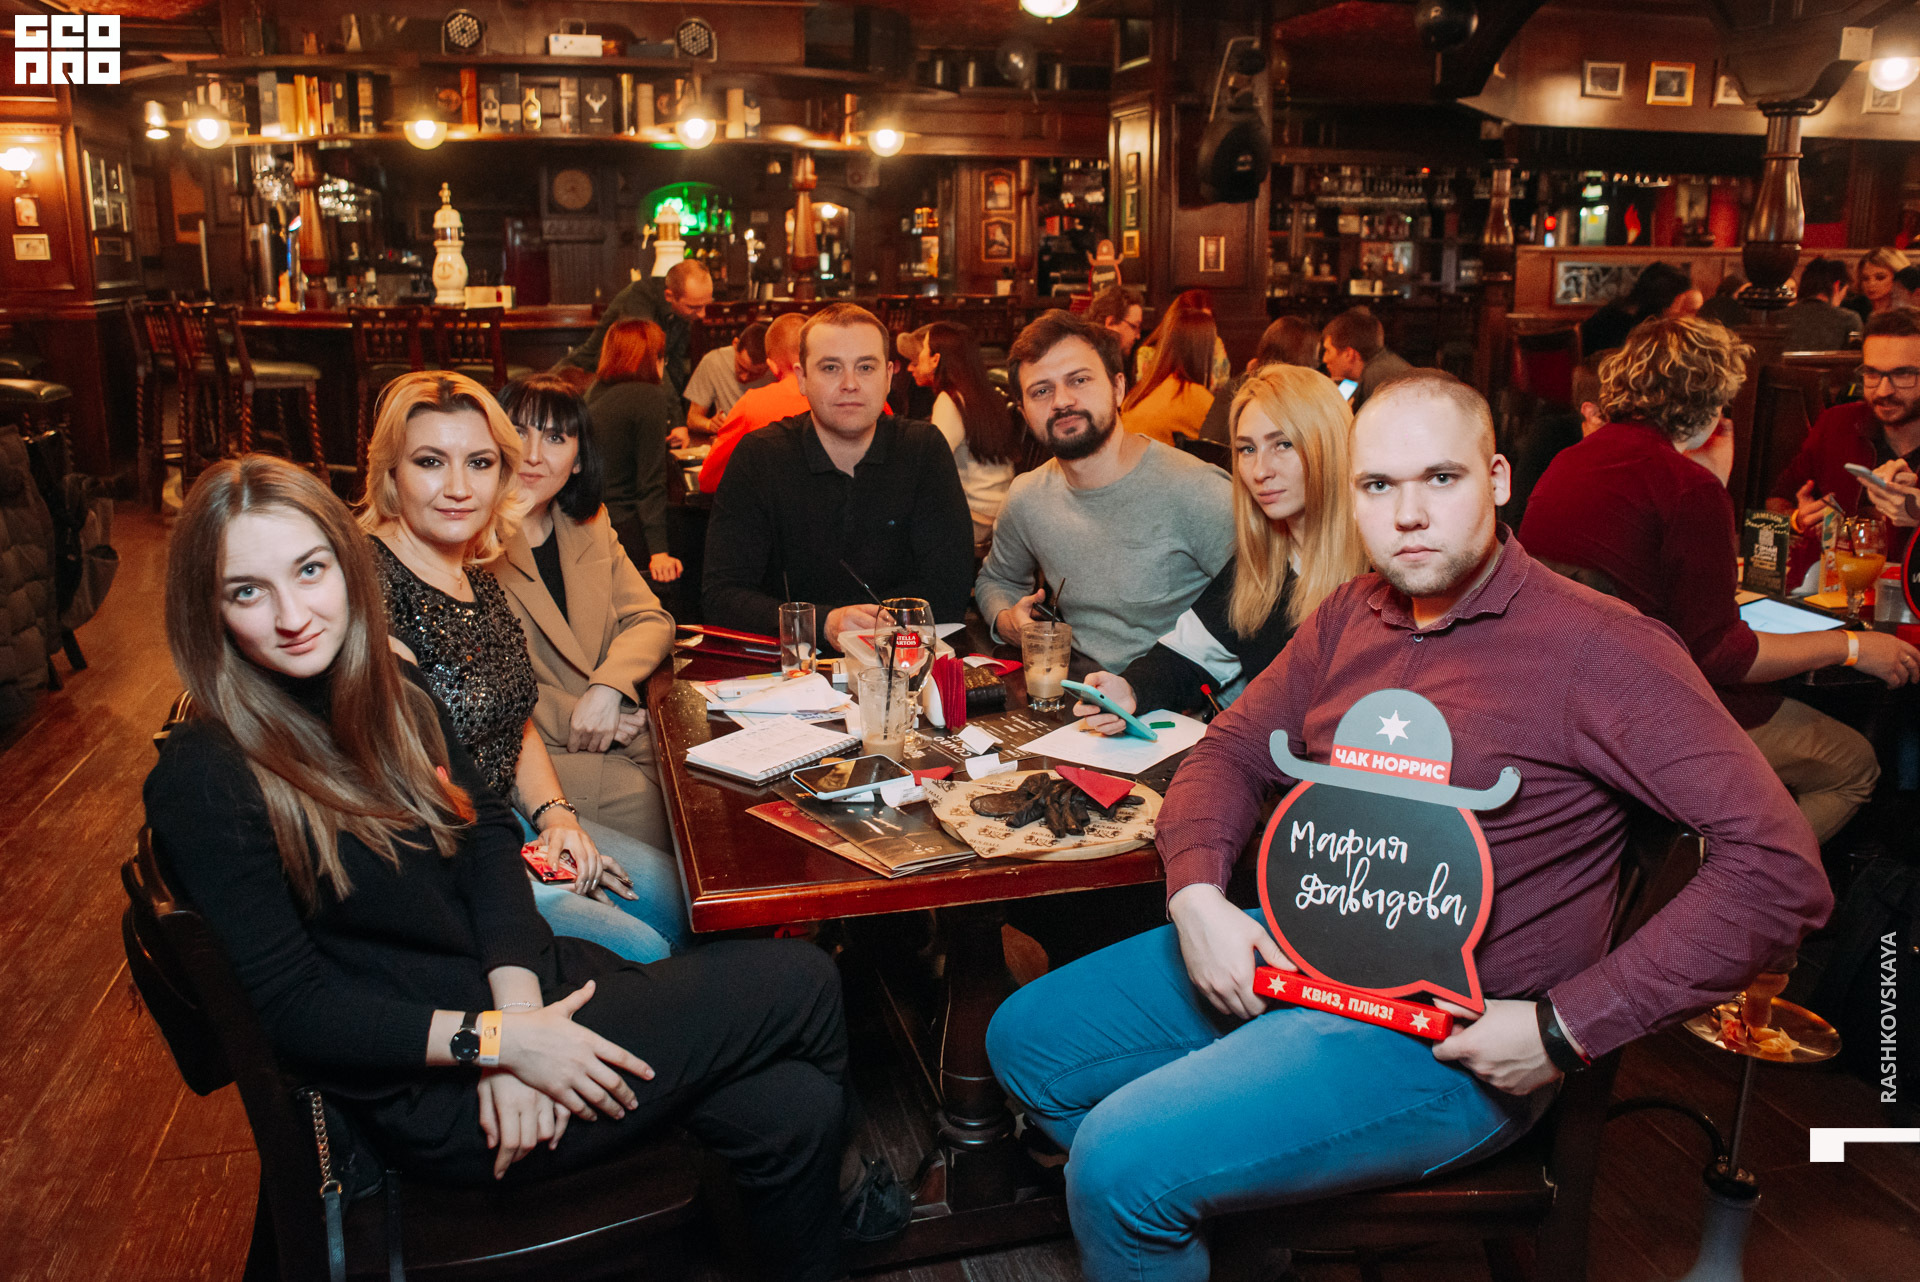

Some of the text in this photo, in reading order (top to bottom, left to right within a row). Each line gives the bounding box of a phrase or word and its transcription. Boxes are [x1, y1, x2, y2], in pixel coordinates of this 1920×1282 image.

[933, 736, 972, 757] COMBO
[1334, 748, 1446, 780] ЧАК НОРРИС
[1290, 820, 1408, 877] Мафия
[1295, 856, 1467, 930] Давыдова
[1301, 985, 1395, 1021] КВИЗ, ПЛИЗ!
